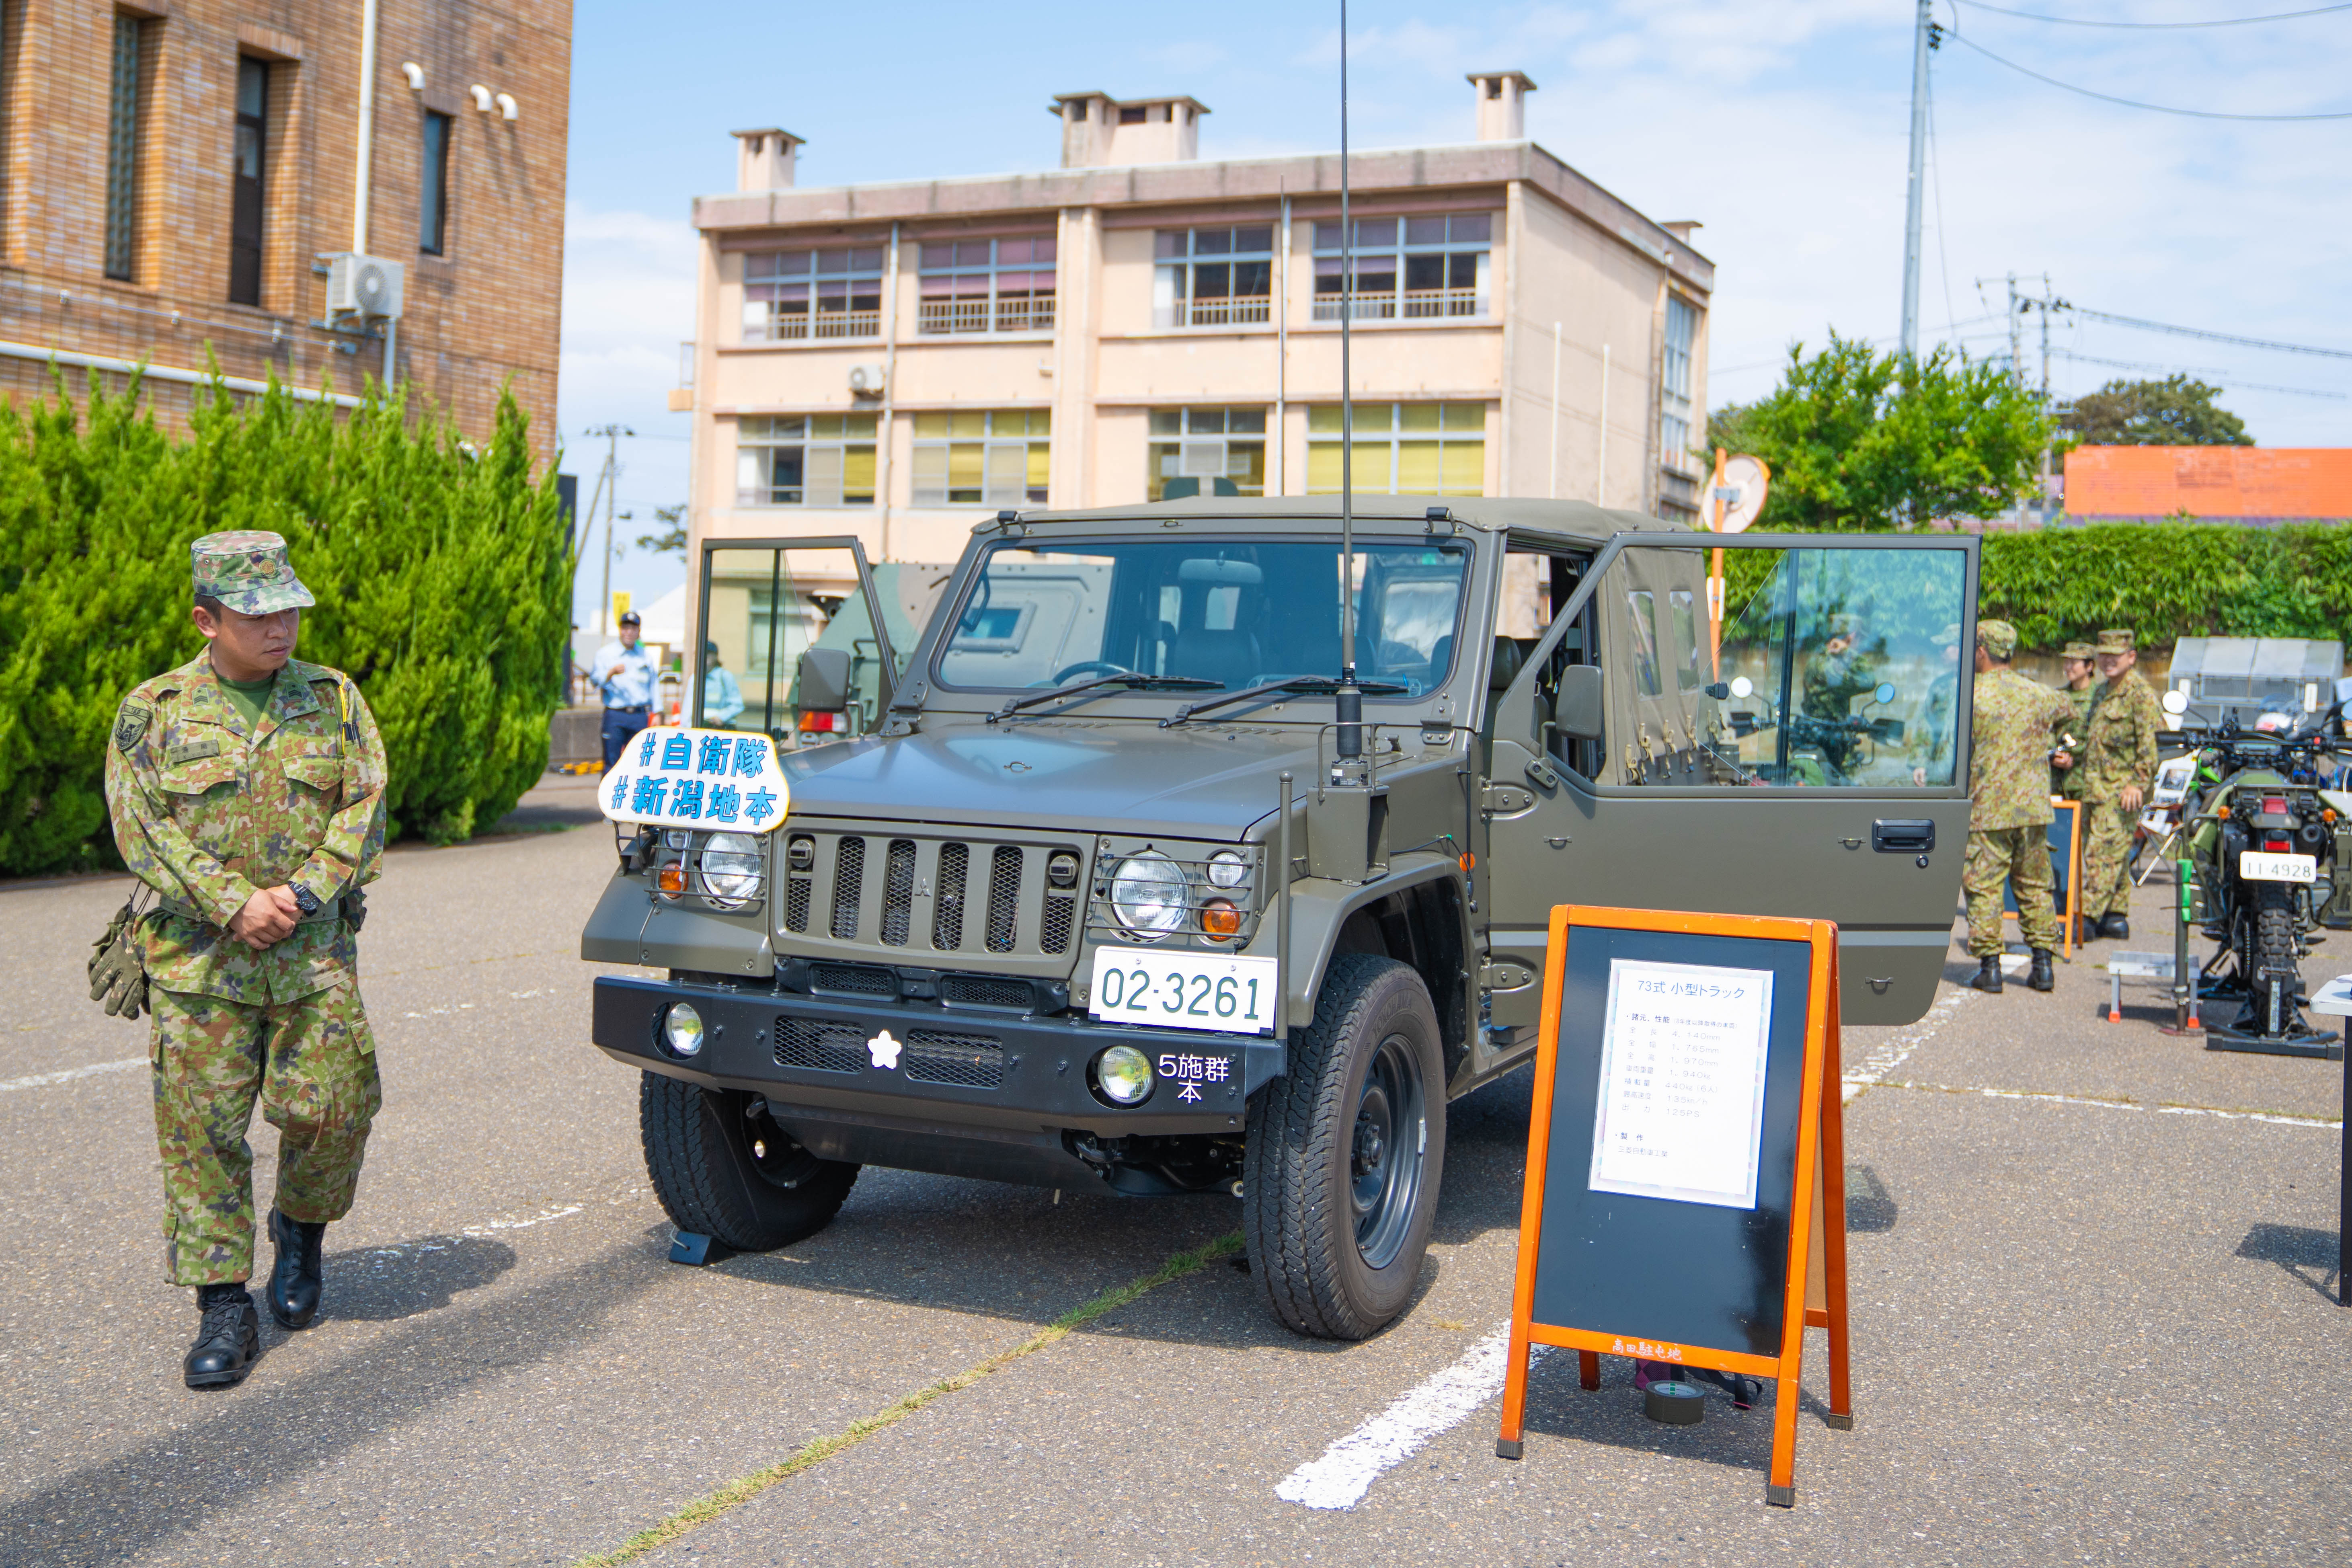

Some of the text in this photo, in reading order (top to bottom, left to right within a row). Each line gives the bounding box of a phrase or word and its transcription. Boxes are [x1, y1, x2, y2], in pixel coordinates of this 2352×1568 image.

[639, 732, 768, 778] #自衛隊
[611, 775, 777, 825] #新潟地本
[1102, 968, 1259, 1020] 02-3261
[1638, 980, 1745, 999] 73式 小型トラック
[1158, 1053, 1229, 1082] 5施群
[1178, 1079, 1202, 1104] 本
[1613, 1338, 1682, 1361] 高田駐屯地
